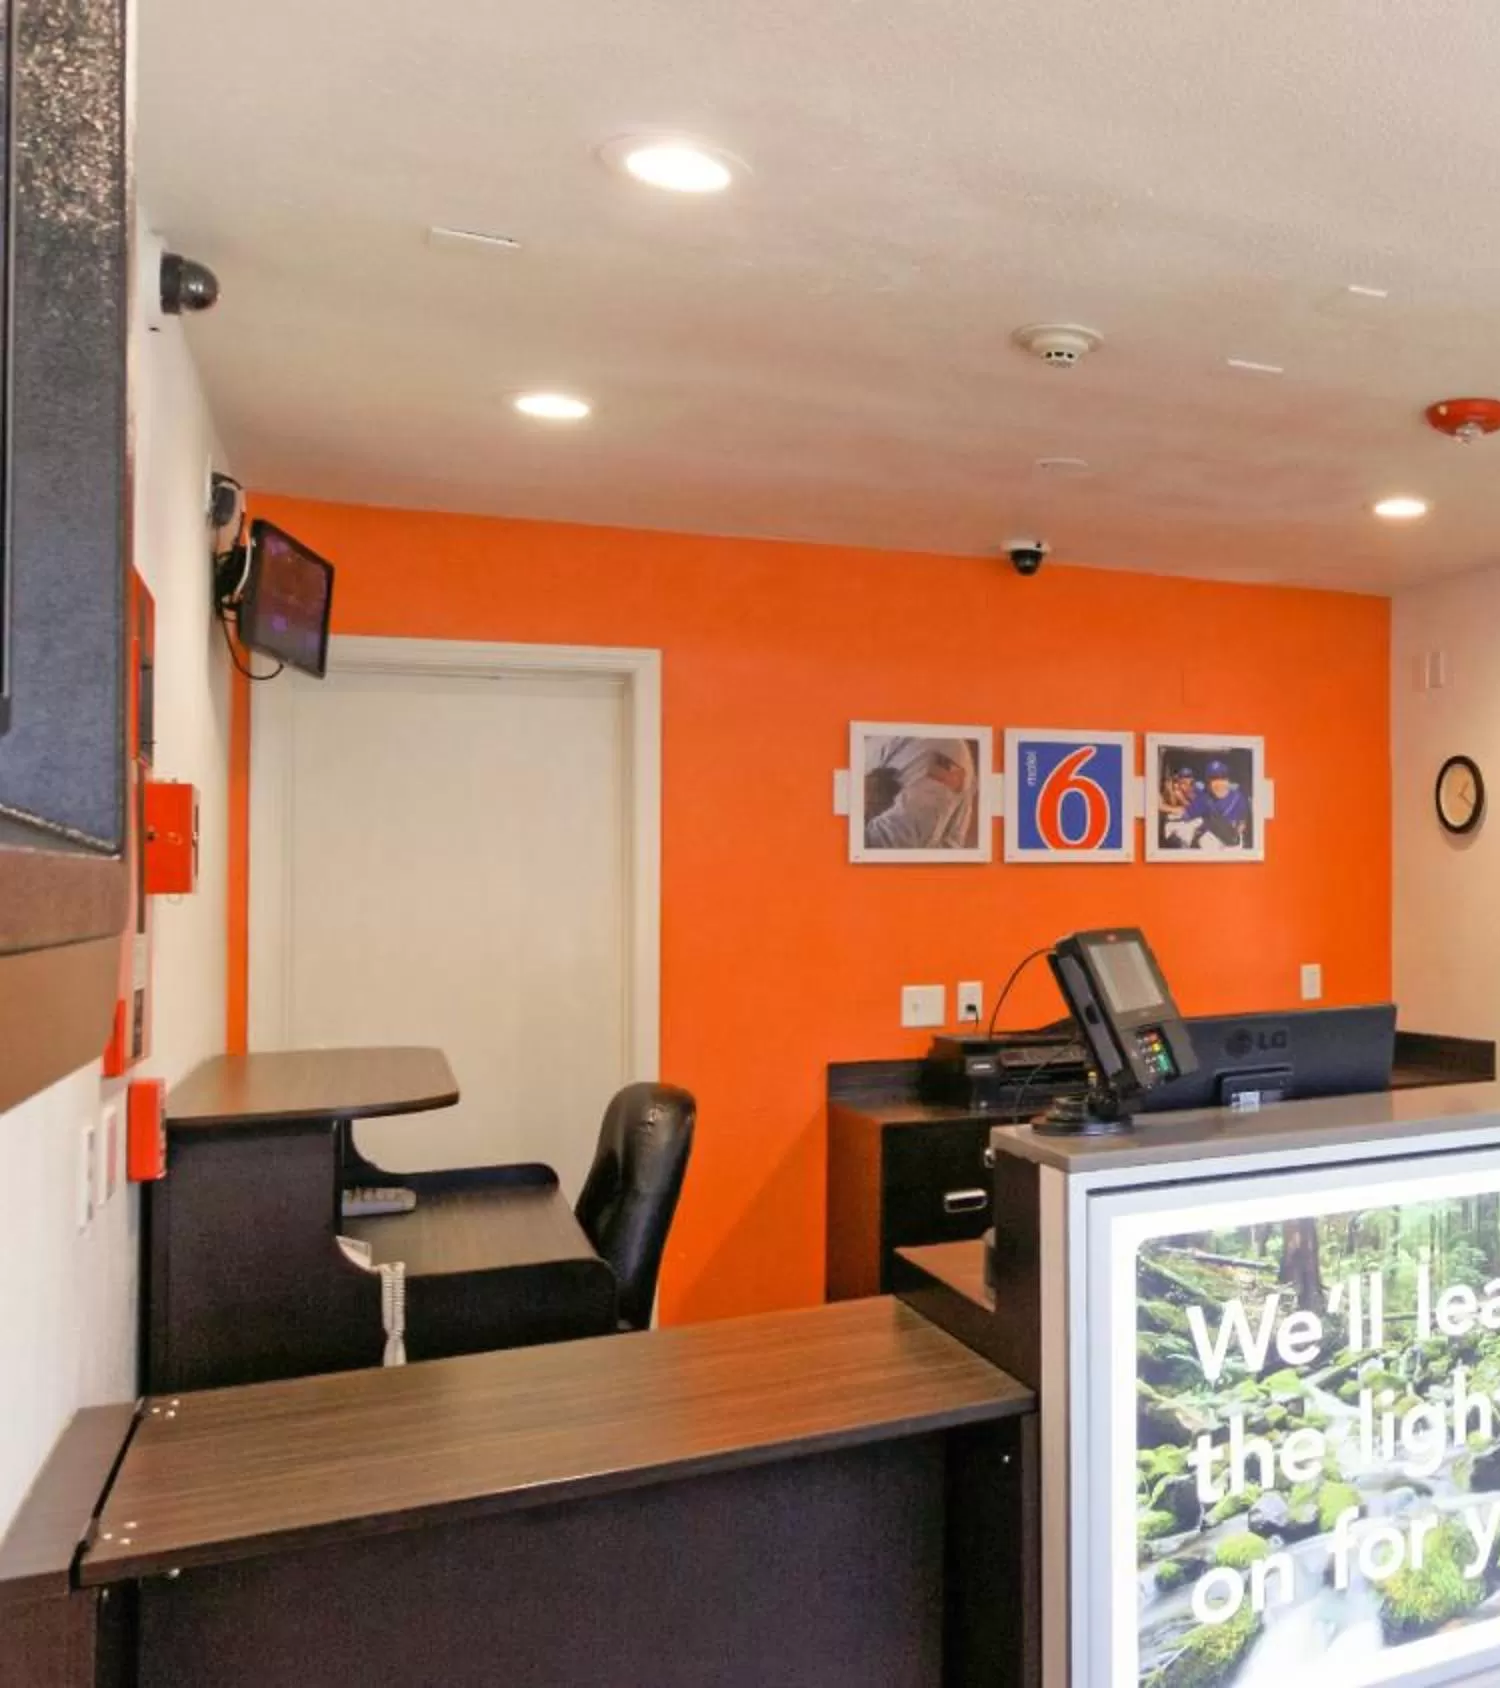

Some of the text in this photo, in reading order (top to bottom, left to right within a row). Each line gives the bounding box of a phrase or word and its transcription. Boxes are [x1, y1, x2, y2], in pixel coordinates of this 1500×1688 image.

[1036, 745, 1111, 850] 6
[1256, 1028, 1288, 1052] LG
[1186, 1271, 1384, 1384] We'll
[1187, 1413, 1326, 1504] the
[1191, 1550, 1295, 1625] on
[1326, 1503, 1439, 1590] for
